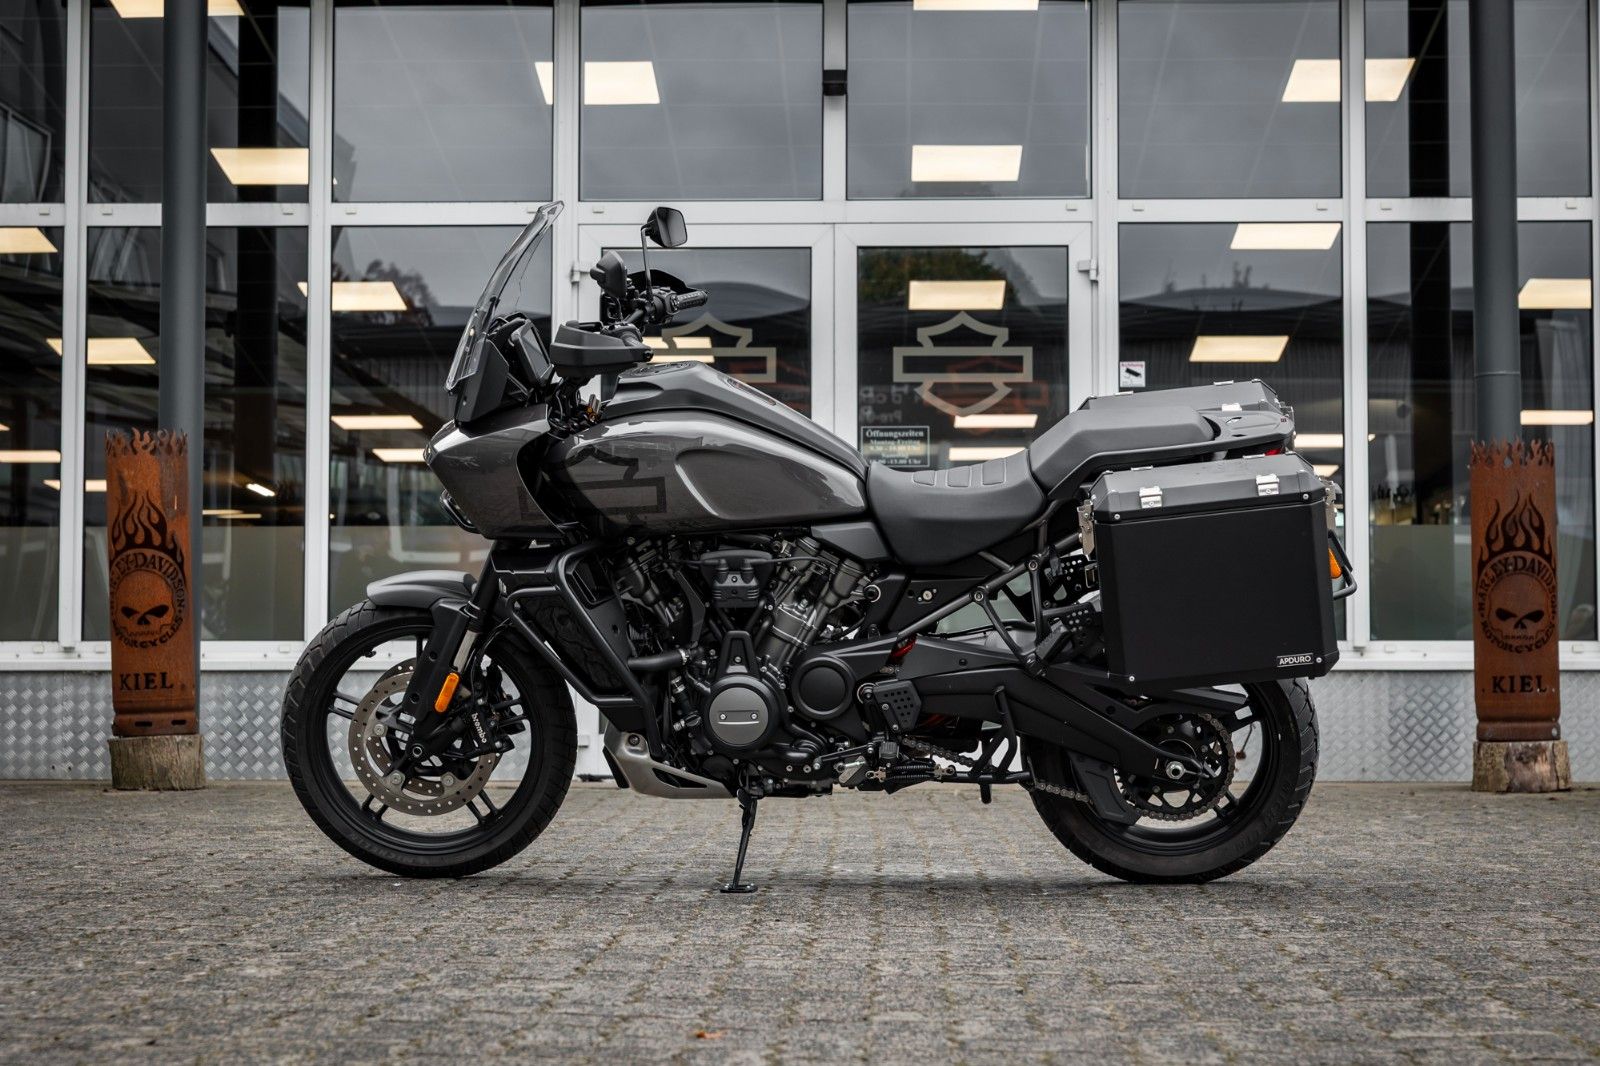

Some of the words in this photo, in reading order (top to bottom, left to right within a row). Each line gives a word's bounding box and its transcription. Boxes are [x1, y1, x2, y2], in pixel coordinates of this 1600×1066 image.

[866, 428, 924, 438] Öffnungszeiten
[119, 672, 174, 691] KIEL
[1491, 675, 1547, 693] KIEL
[471, 712, 487, 743] brembo
